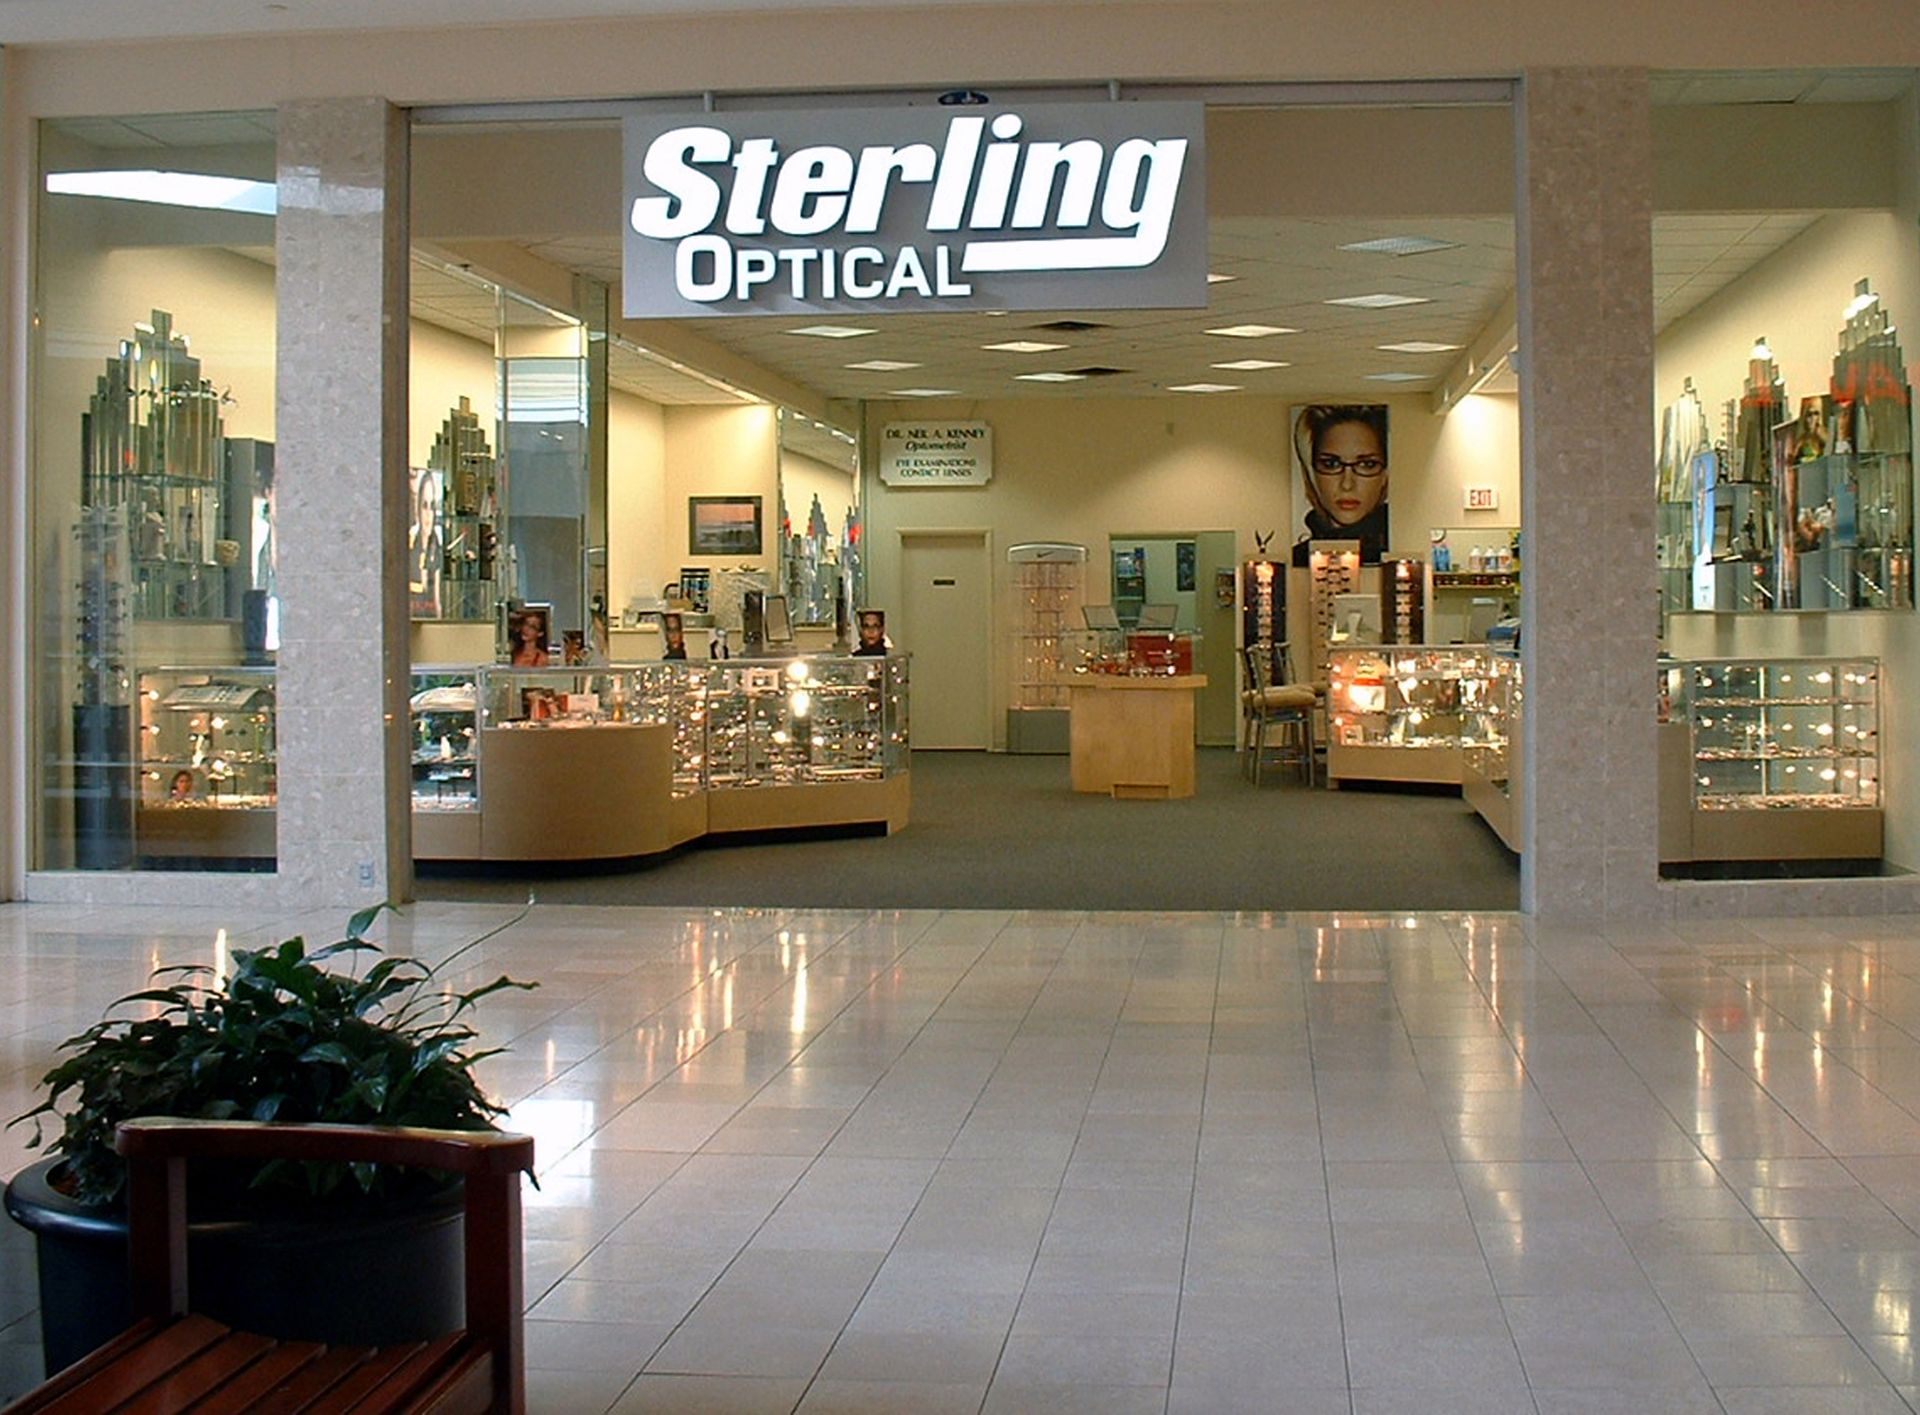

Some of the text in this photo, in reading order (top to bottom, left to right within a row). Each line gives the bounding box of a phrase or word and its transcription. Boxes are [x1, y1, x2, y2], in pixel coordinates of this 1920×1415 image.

[631, 113, 1187, 272] Sterling
[675, 235, 972, 302] OPTICAL
[905, 441, 967, 452] Optometrist
[900, 468, 973, 477] CONTACT LENSES
[1470, 489, 1491, 506] EXIT
